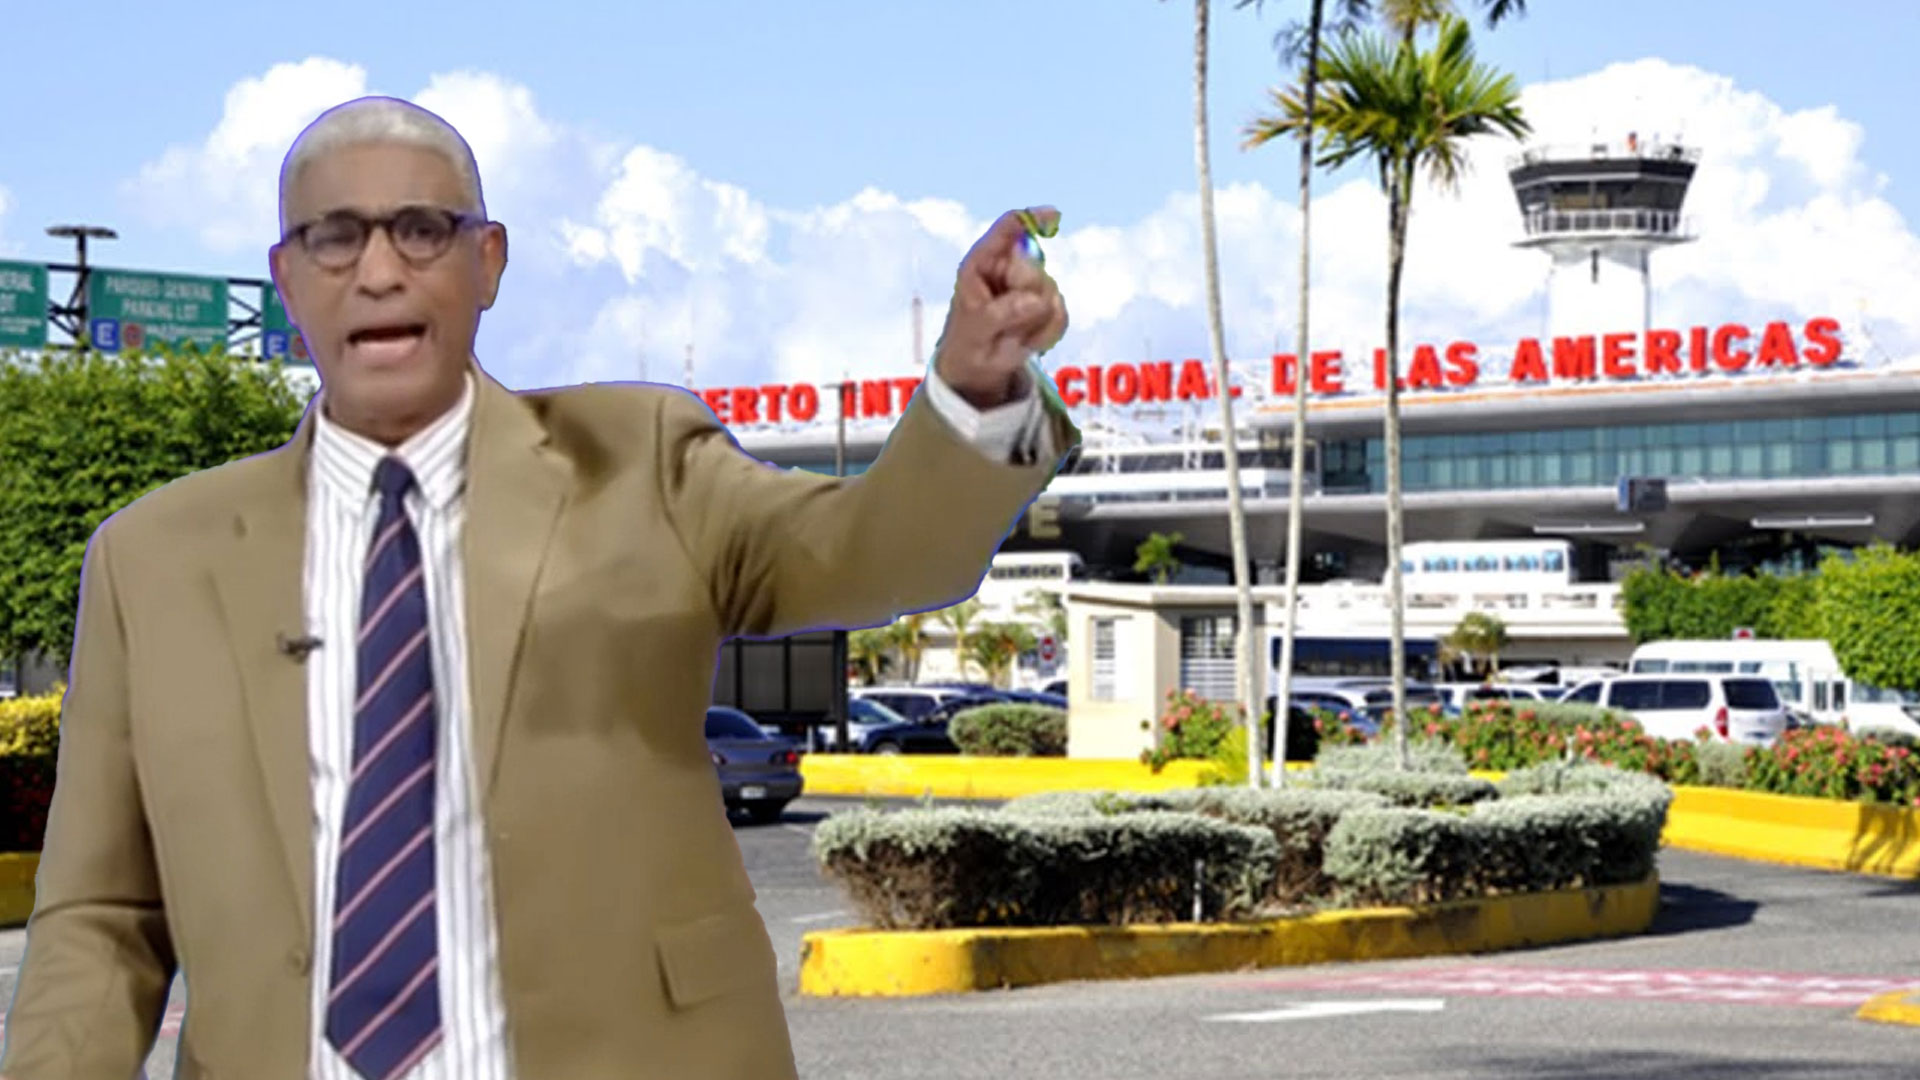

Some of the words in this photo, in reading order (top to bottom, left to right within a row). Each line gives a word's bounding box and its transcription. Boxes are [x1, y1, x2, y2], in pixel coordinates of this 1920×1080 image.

[692, 382, 819, 424] ERTO
[1272, 350, 1343, 396] DE
[1373, 340, 1480, 391] LAS
[1509, 316, 1844, 383] AMERICAS
